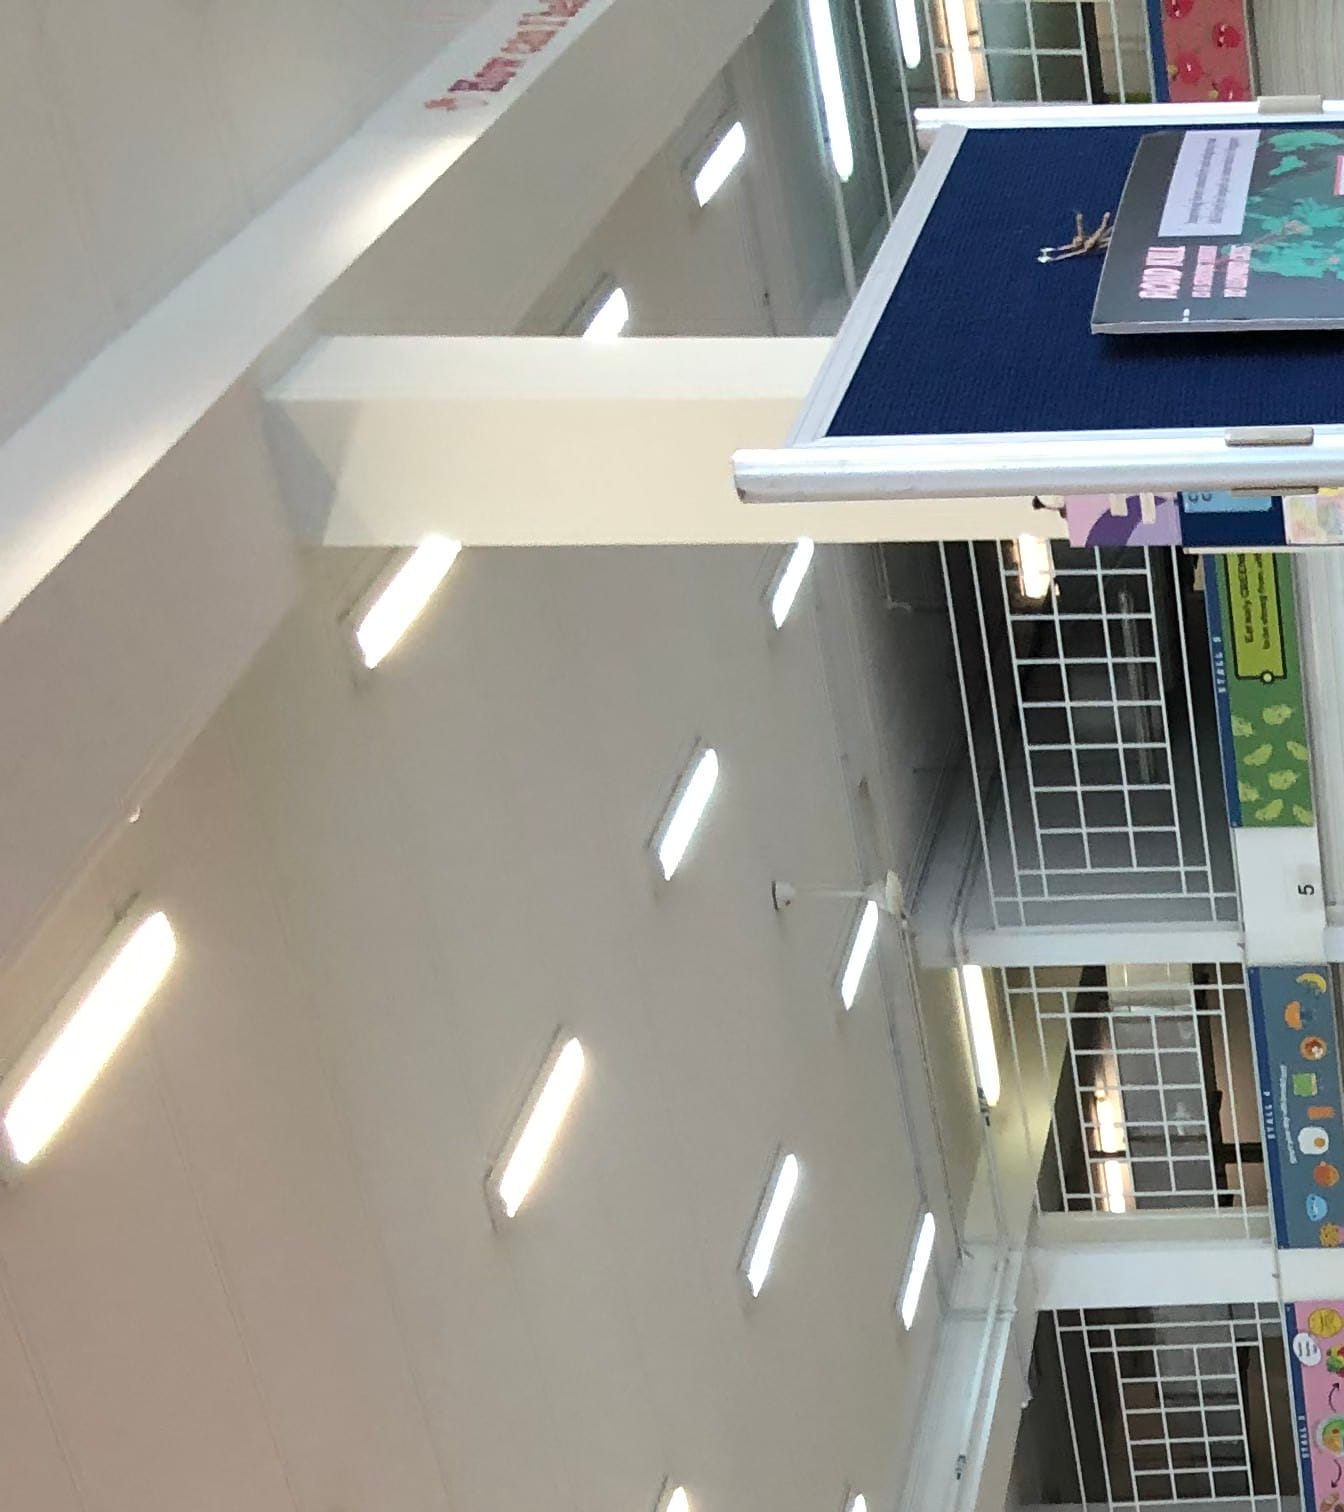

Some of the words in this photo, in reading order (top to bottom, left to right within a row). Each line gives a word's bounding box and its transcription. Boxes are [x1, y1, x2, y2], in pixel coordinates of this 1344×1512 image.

[1145, 246, 1186, 267] KILL
[1138, 268, 1182, 299] ROAD
[1298, 884, 1314, 896] 5
[1265, 1105, 1275, 1139] STALL
